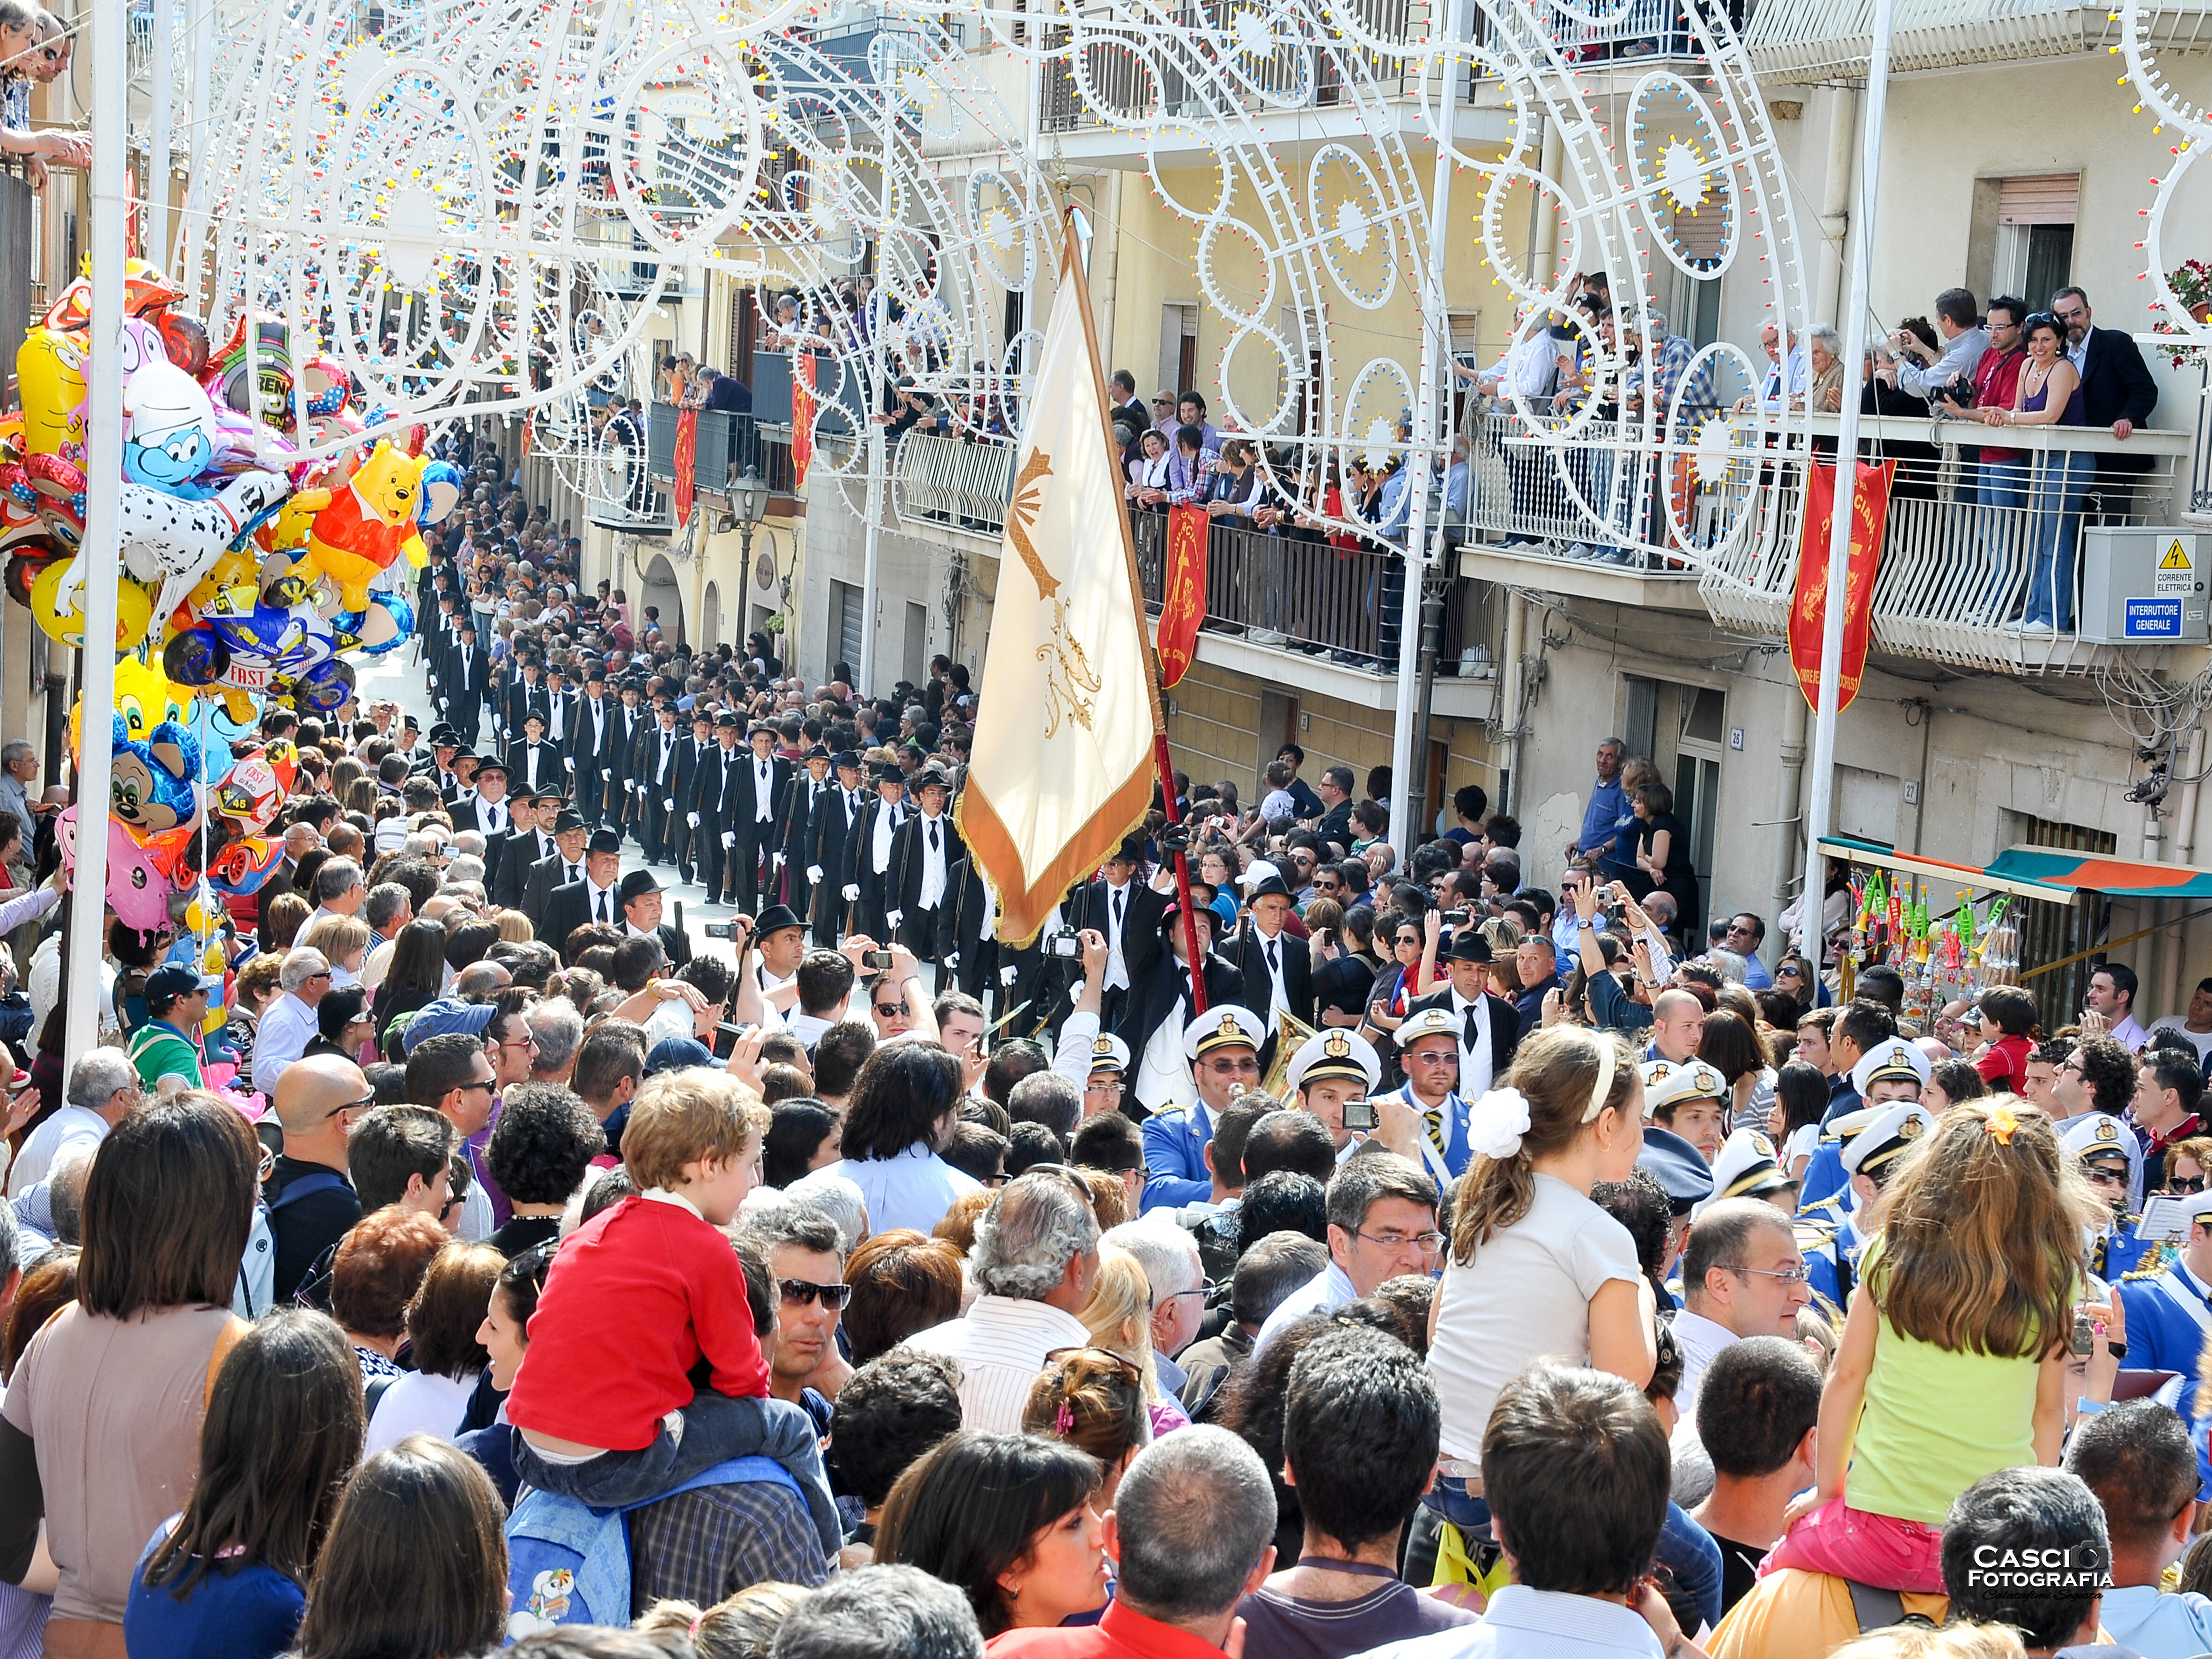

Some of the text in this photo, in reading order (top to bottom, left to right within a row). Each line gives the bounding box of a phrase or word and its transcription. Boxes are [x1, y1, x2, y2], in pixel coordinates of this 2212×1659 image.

[2129, 605, 2178, 616] INTERRUTTORE
[2136, 619, 2171, 630] GENERALE
[258, 642, 278, 655] GRABO
[230, 665, 265, 686] FAST
[1733, 732, 1740, 745] 26
[244, 766, 267, 784] FAST
[1906, 784, 1915, 798] 27
[233, 799, 246, 809] 45
